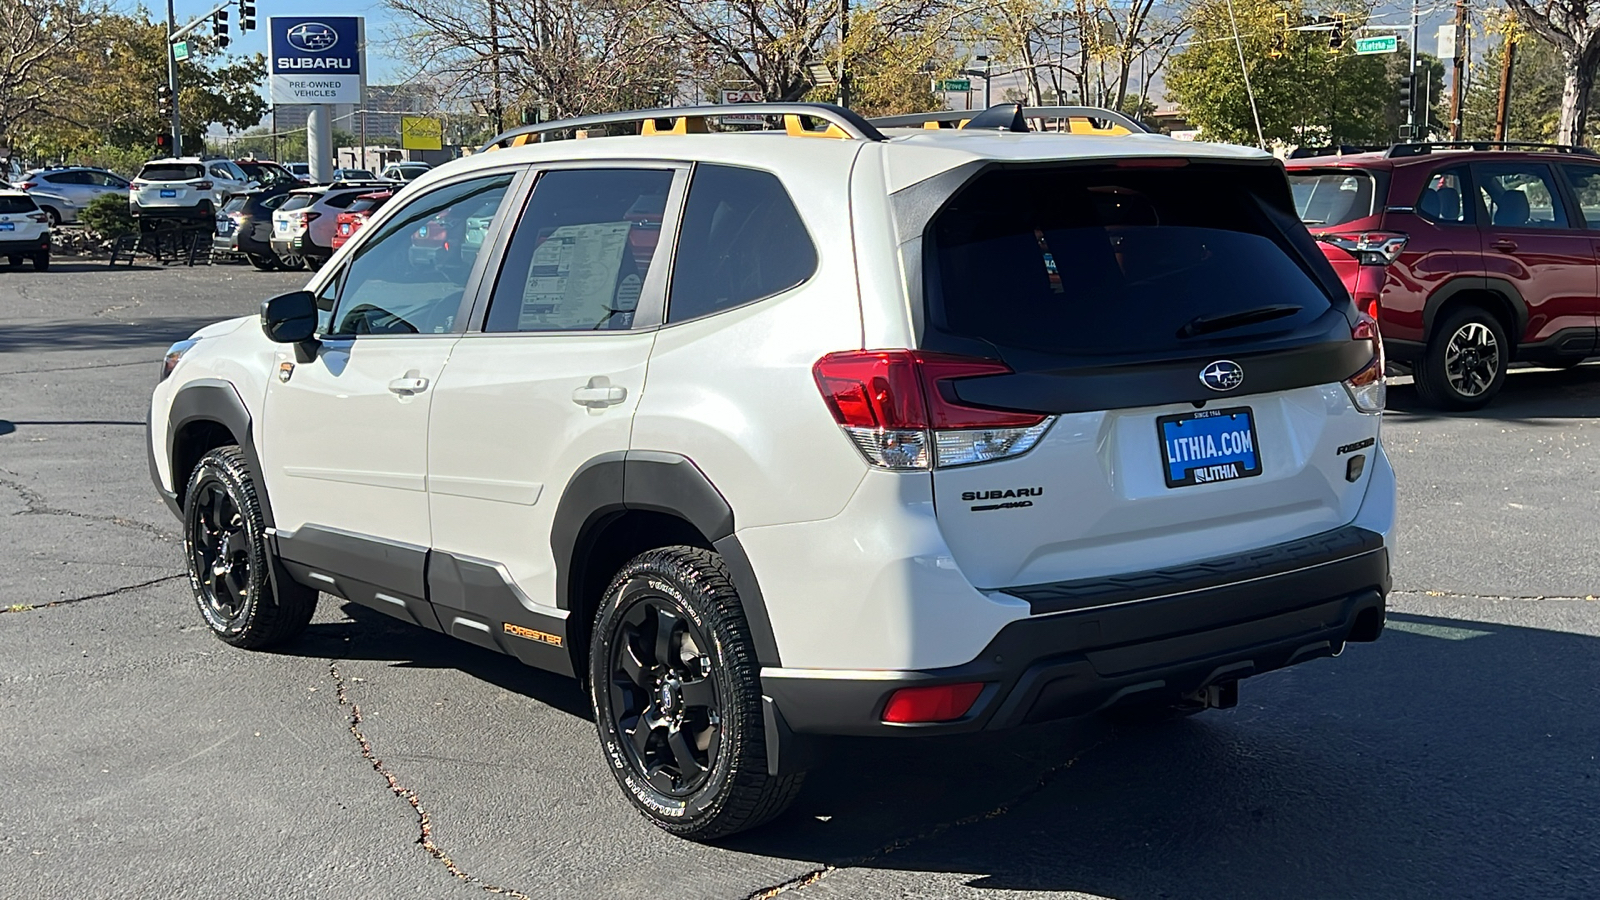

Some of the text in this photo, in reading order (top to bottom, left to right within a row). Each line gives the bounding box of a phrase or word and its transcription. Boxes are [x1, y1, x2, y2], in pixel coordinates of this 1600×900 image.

[278, 58, 351, 69] SUBARU
[289, 81, 342, 89] PRE-OWNED
[945, 82, 962, 90] Grove
[294, 89, 337, 97] VEHICLES
[1166, 430, 1254, 464] LITHIA.COM
[1204, 463, 1240, 482] LITHIA
[962, 487, 1043, 501] SUBARU
[995, 500, 1034, 510] AWD
[503, 622, 563, 646] FORESTER
